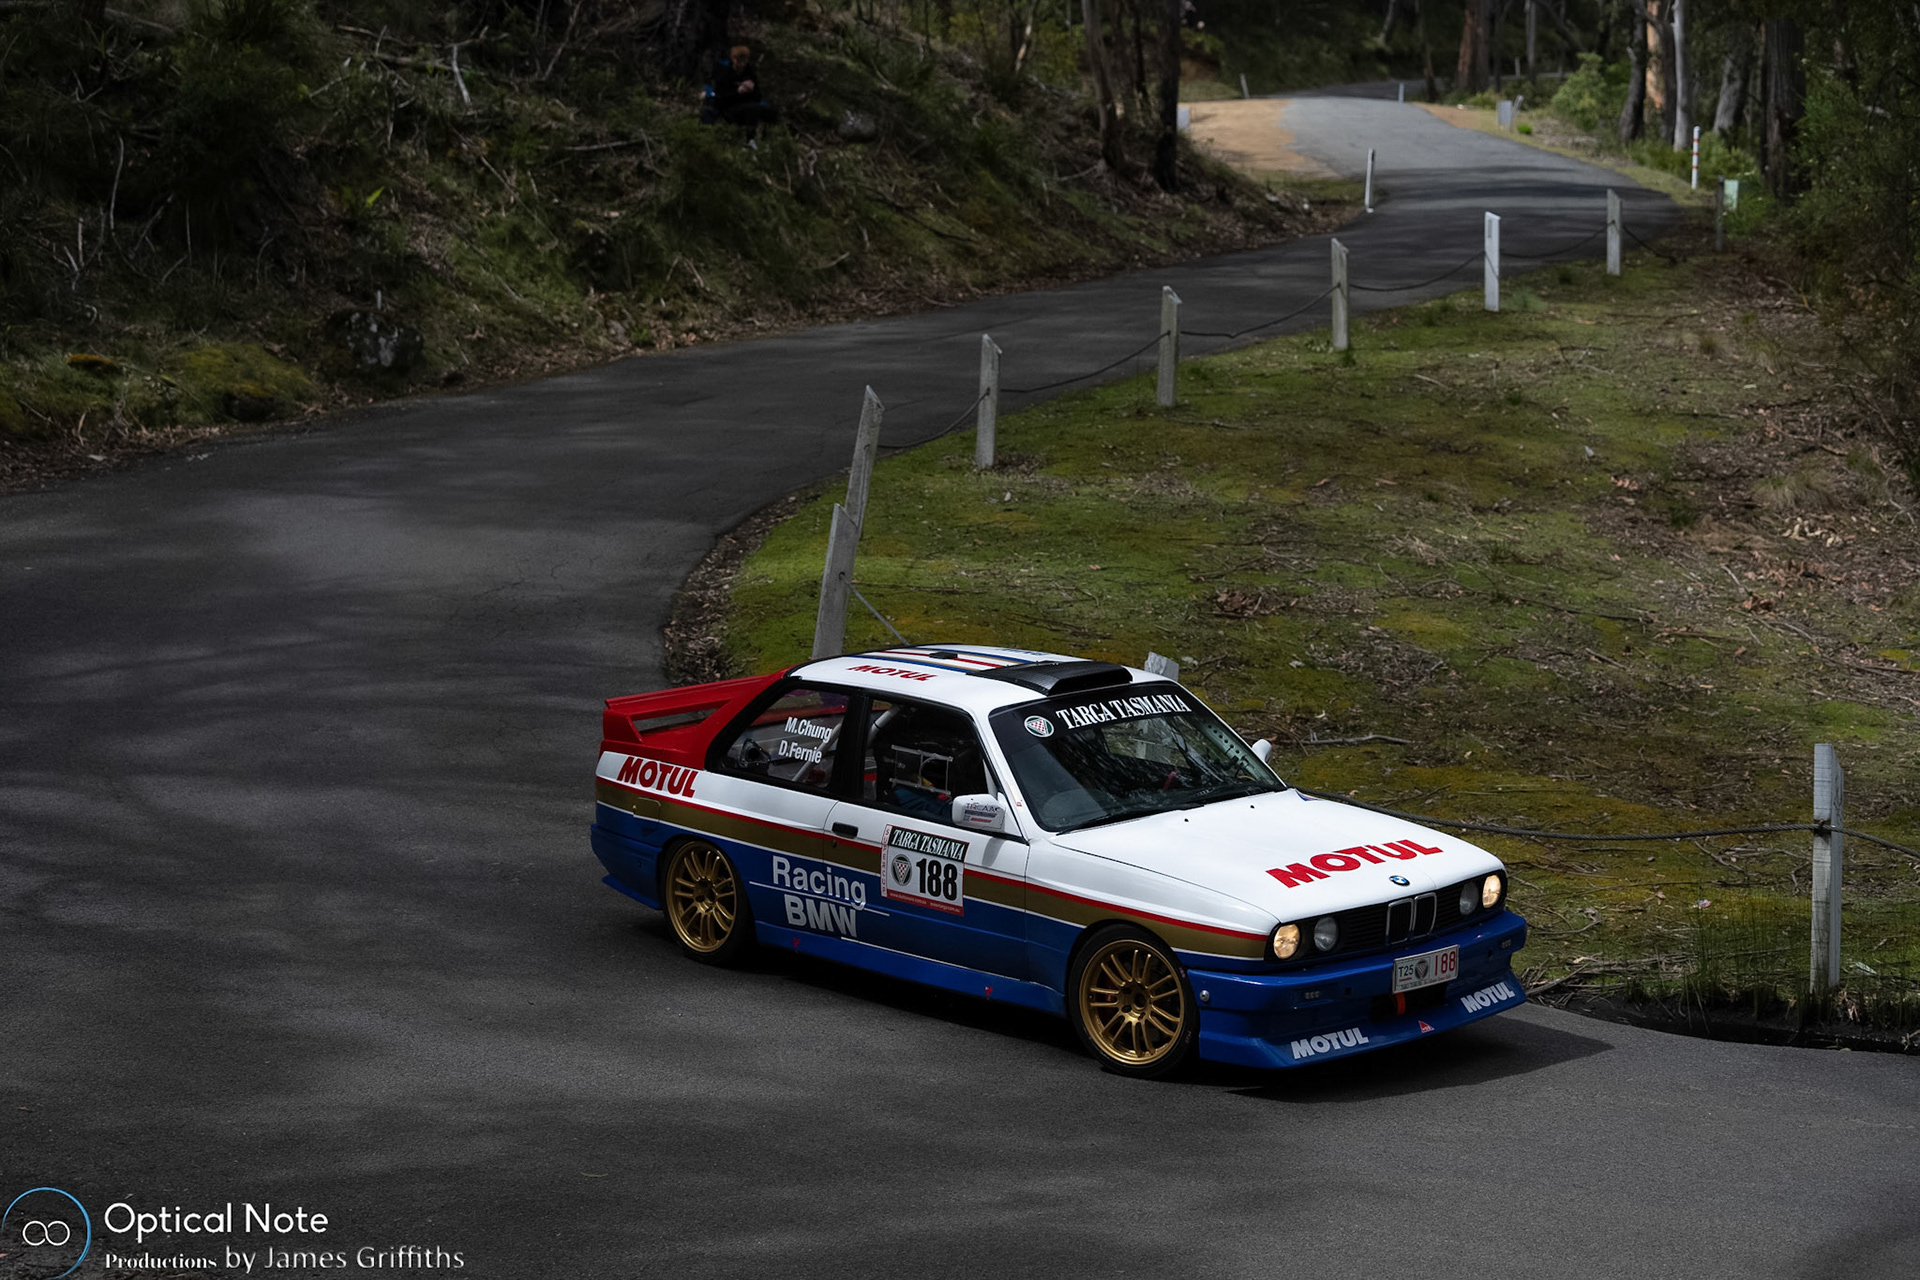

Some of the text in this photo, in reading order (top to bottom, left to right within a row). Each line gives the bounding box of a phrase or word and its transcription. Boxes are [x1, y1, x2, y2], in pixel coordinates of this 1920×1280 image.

[847, 664, 937, 682] MOTUL
[1056, 694, 1192, 730] TARGA TASMANIA
[785, 717, 833, 743] M.Chung
[778, 740, 823, 764] D.Fernie
[617, 756, 698, 798] MOTUL
[892, 830, 965, 860] TARGA TASMANIA
[916, 858, 958, 901] 188
[1265, 839, 1443, 889] MOTUL
[772, 855, 867, 911] Racing
[783, 894, 857, 938] BMW
[1398, 964, 1414, 977] T25
[1435, 951, 1456, 976] 188
[1460, 981, 1516, 1014] MOTUL
[1290, 1027, 1370, 1060] MOTUL
